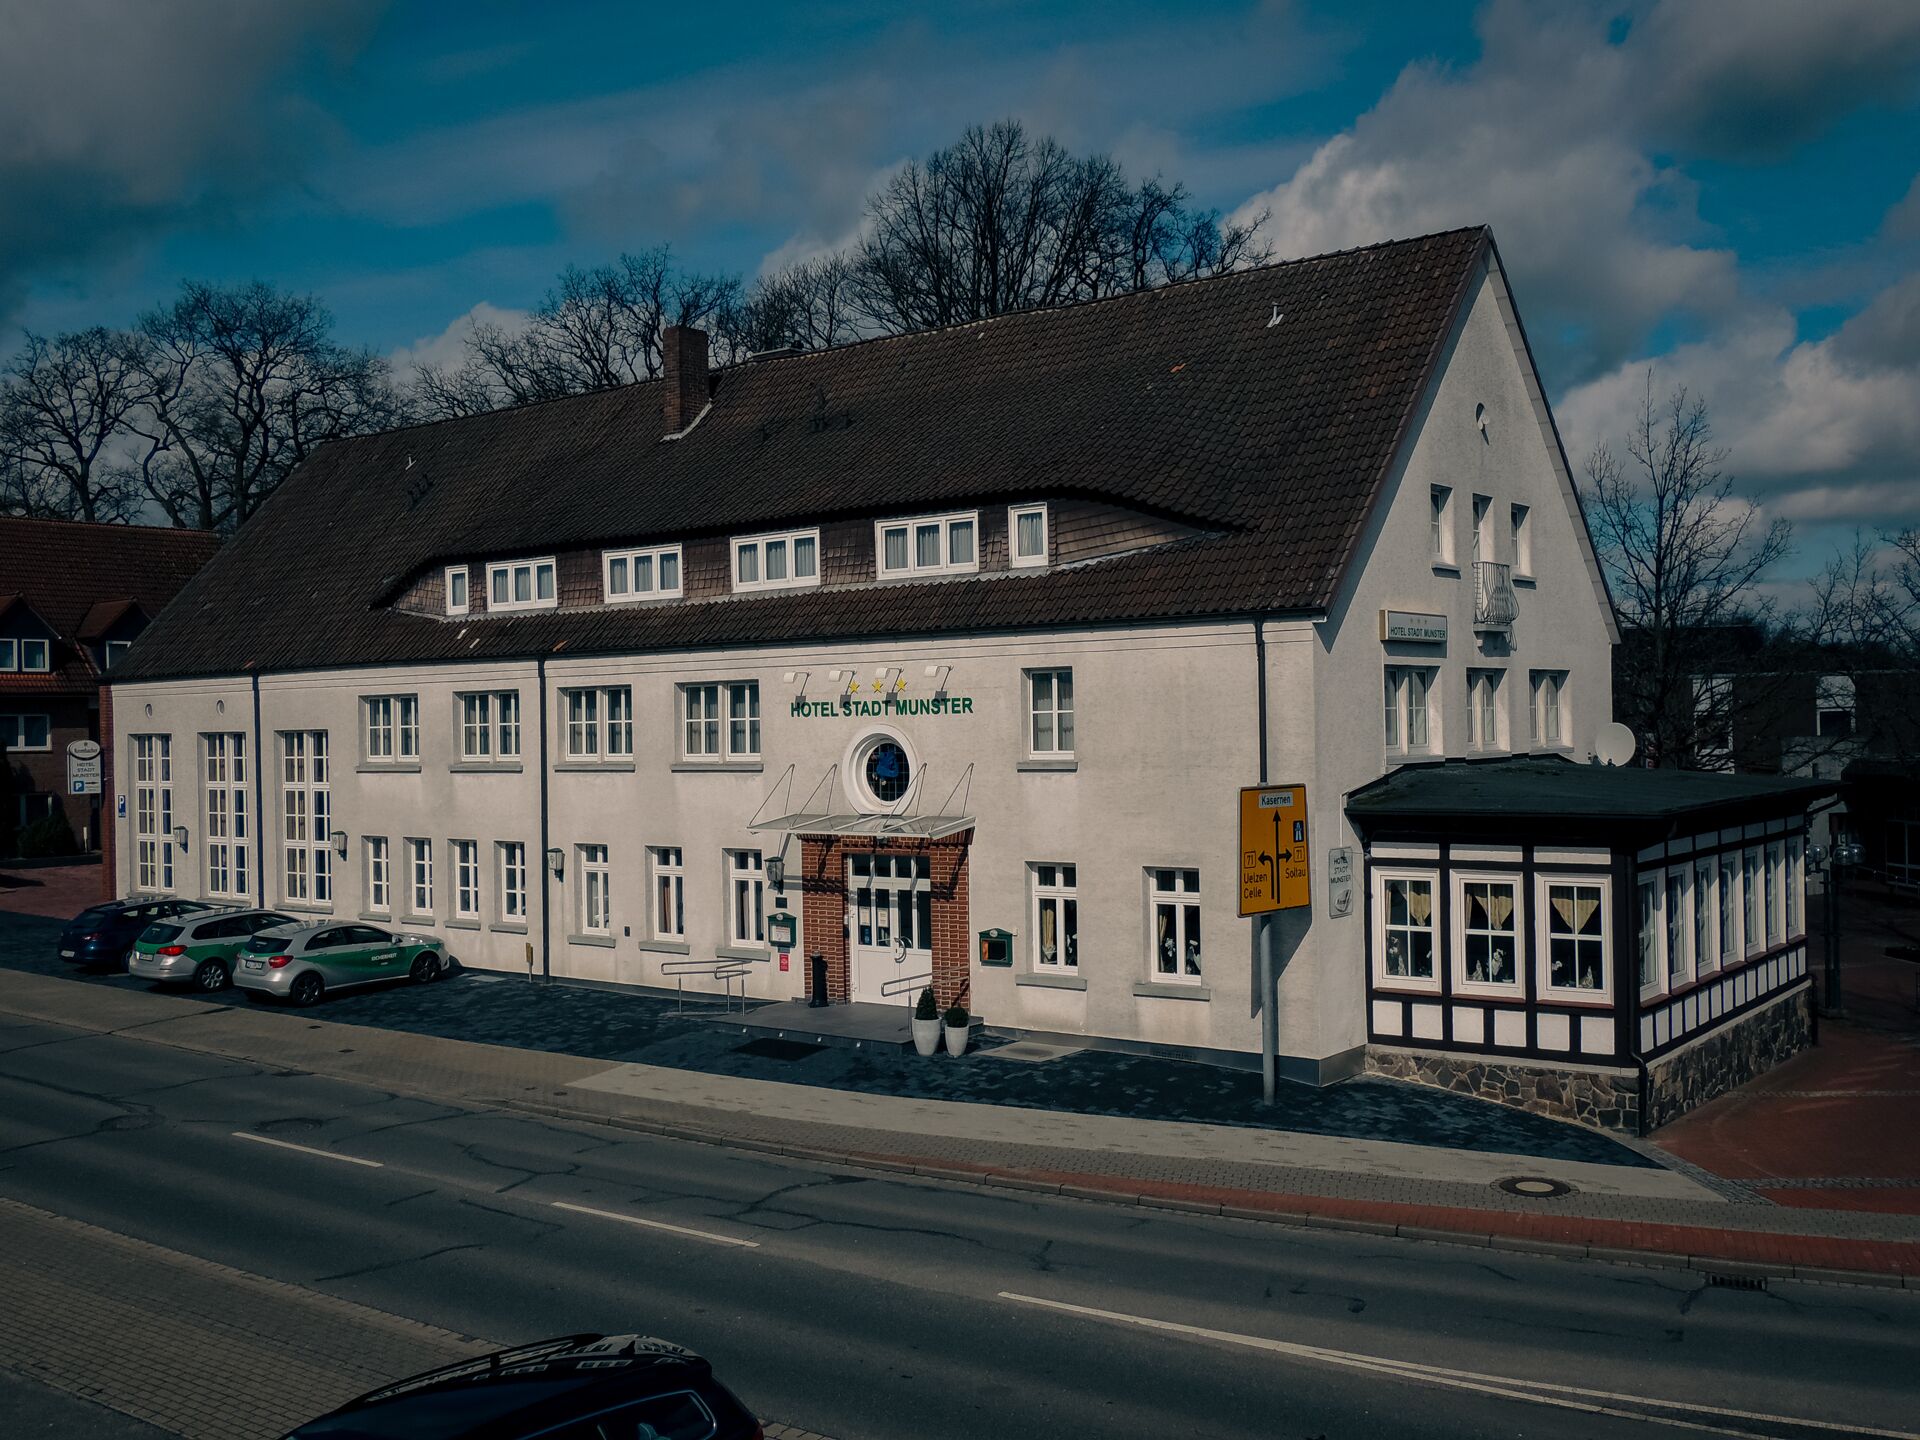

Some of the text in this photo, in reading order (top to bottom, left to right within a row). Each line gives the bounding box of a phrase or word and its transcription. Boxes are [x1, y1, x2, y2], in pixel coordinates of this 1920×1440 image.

[1390, 626, 1446, 639] HOTEL STADT MUNSTER
[790, 697, 973, 717] HOTEL STADT MUNSTER
[75, 782, 82, 791] P
[119, 795, 125, 809] P
[1261, 795, 1291, 805] Kasernen
[1247, 854, 1254, 863] 71
[1296, 849, 1303, 858] 71
[1333, 857, 1348, 865] HOTEL
[1285, 867, 1306, 879] Soltau
[1334, 865, 1348, 874] STADT
[1243, 872, 1268, 884] Uelzen
[1330, 875, 1351, 884] MUNSTER
[1243, 888, 1262, 899] Celle
